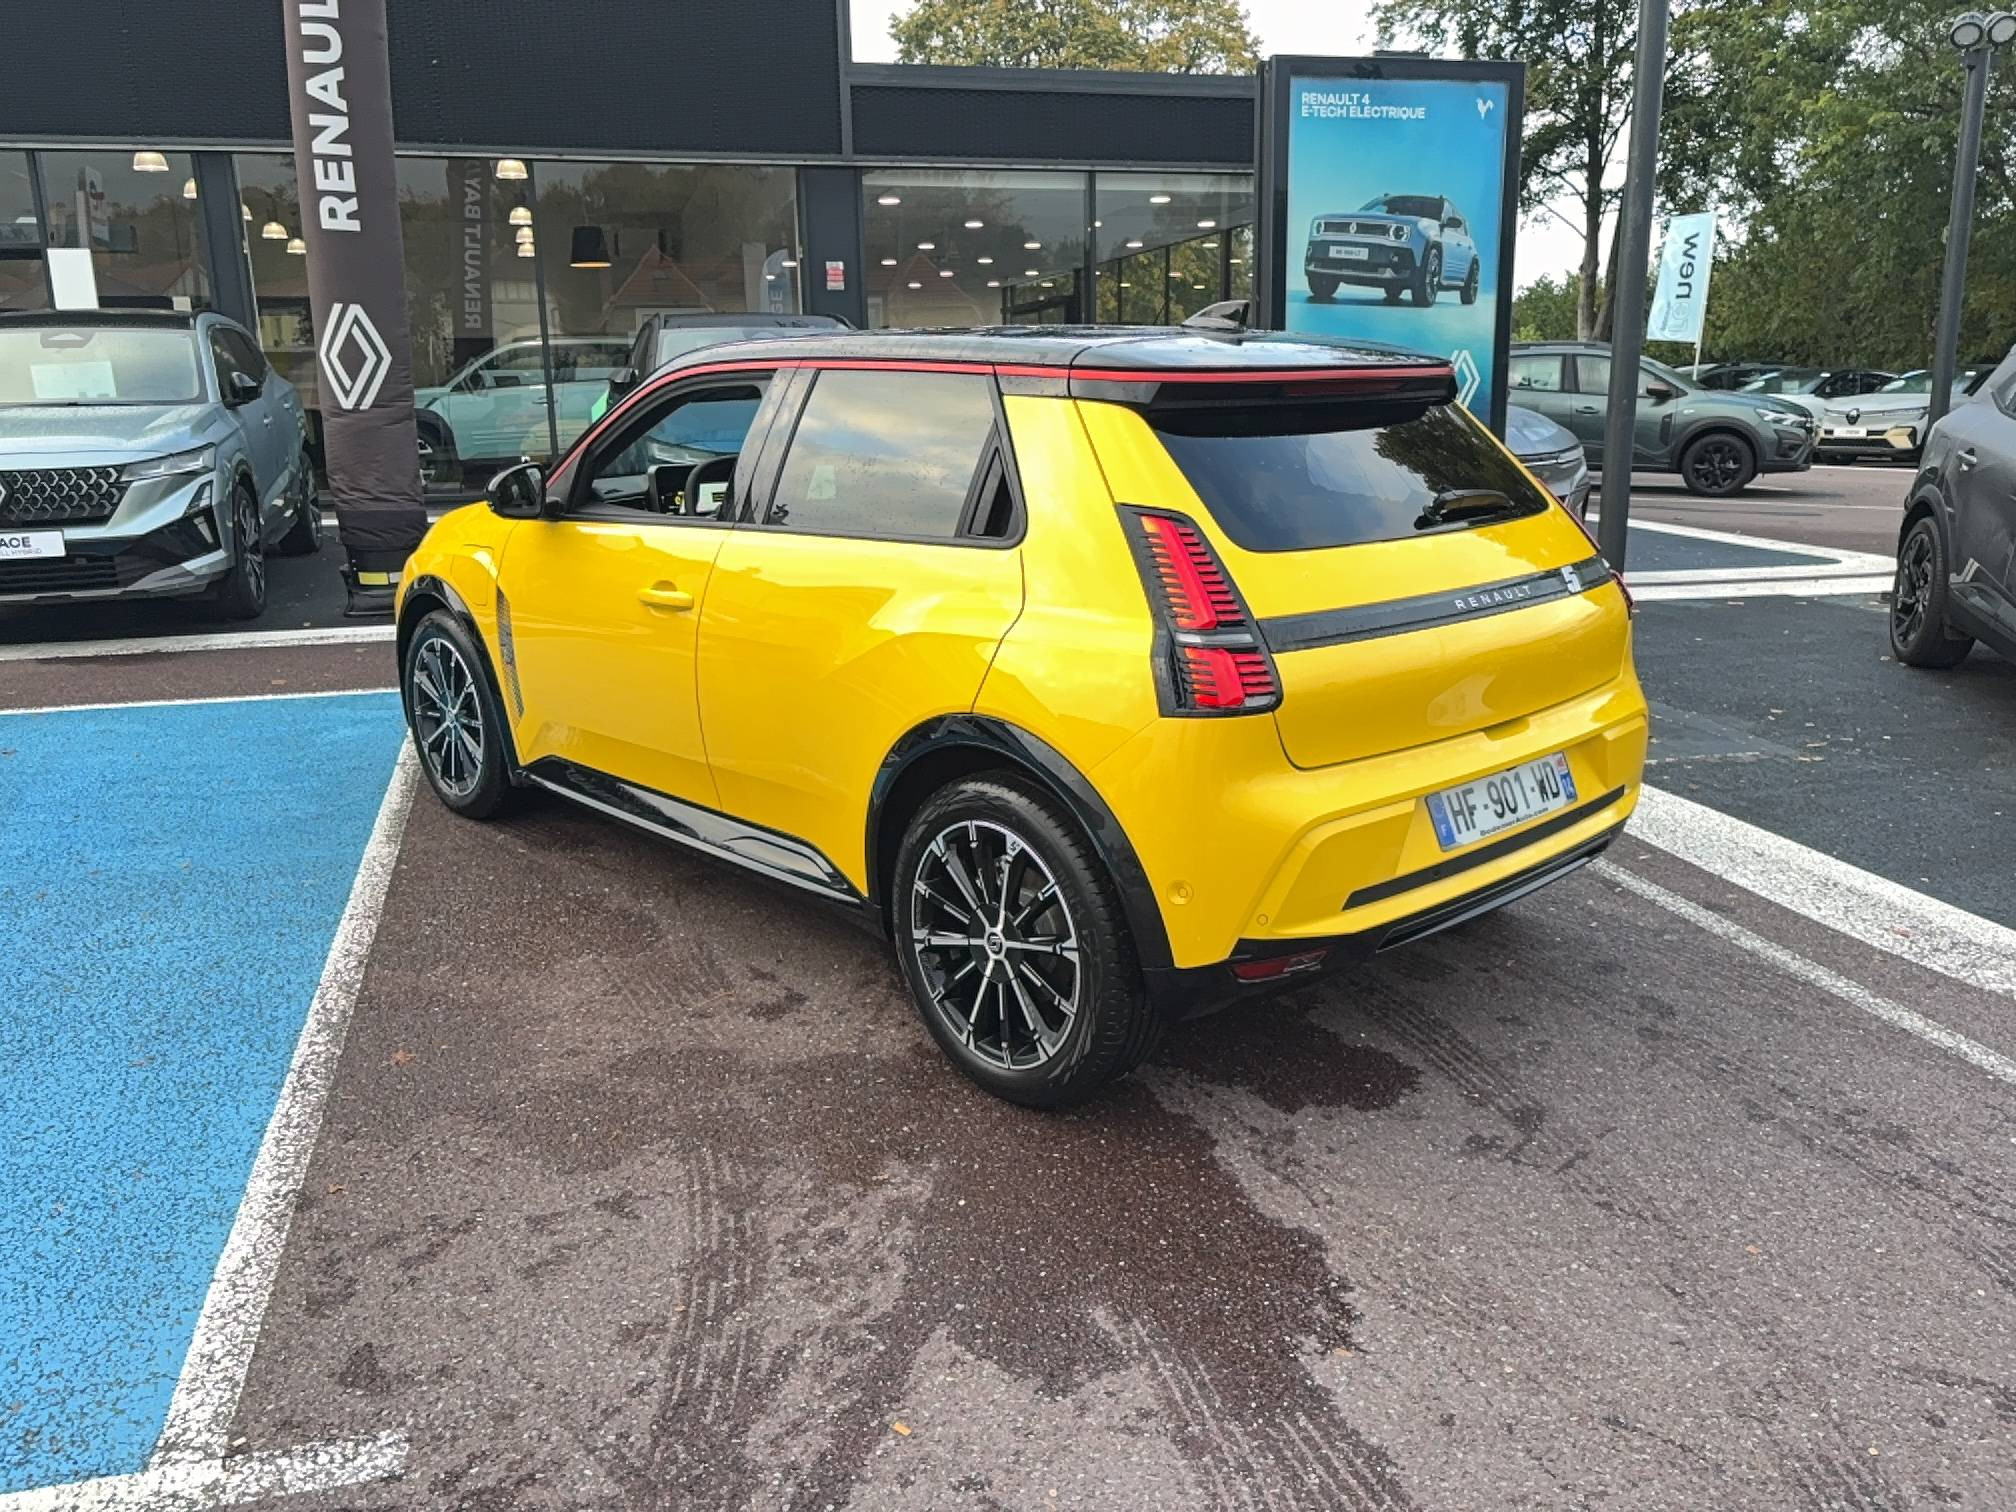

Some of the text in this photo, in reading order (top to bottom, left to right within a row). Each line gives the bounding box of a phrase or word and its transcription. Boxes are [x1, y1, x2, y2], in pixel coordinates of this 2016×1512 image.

[1301, 92, 1370, 105] RENAULT 4
[1301, 105, 1347, 118] E-TECH
[299, 0, 361, 232] RENAUL
[1454, 565, 1582, 610] RENAULT 5
